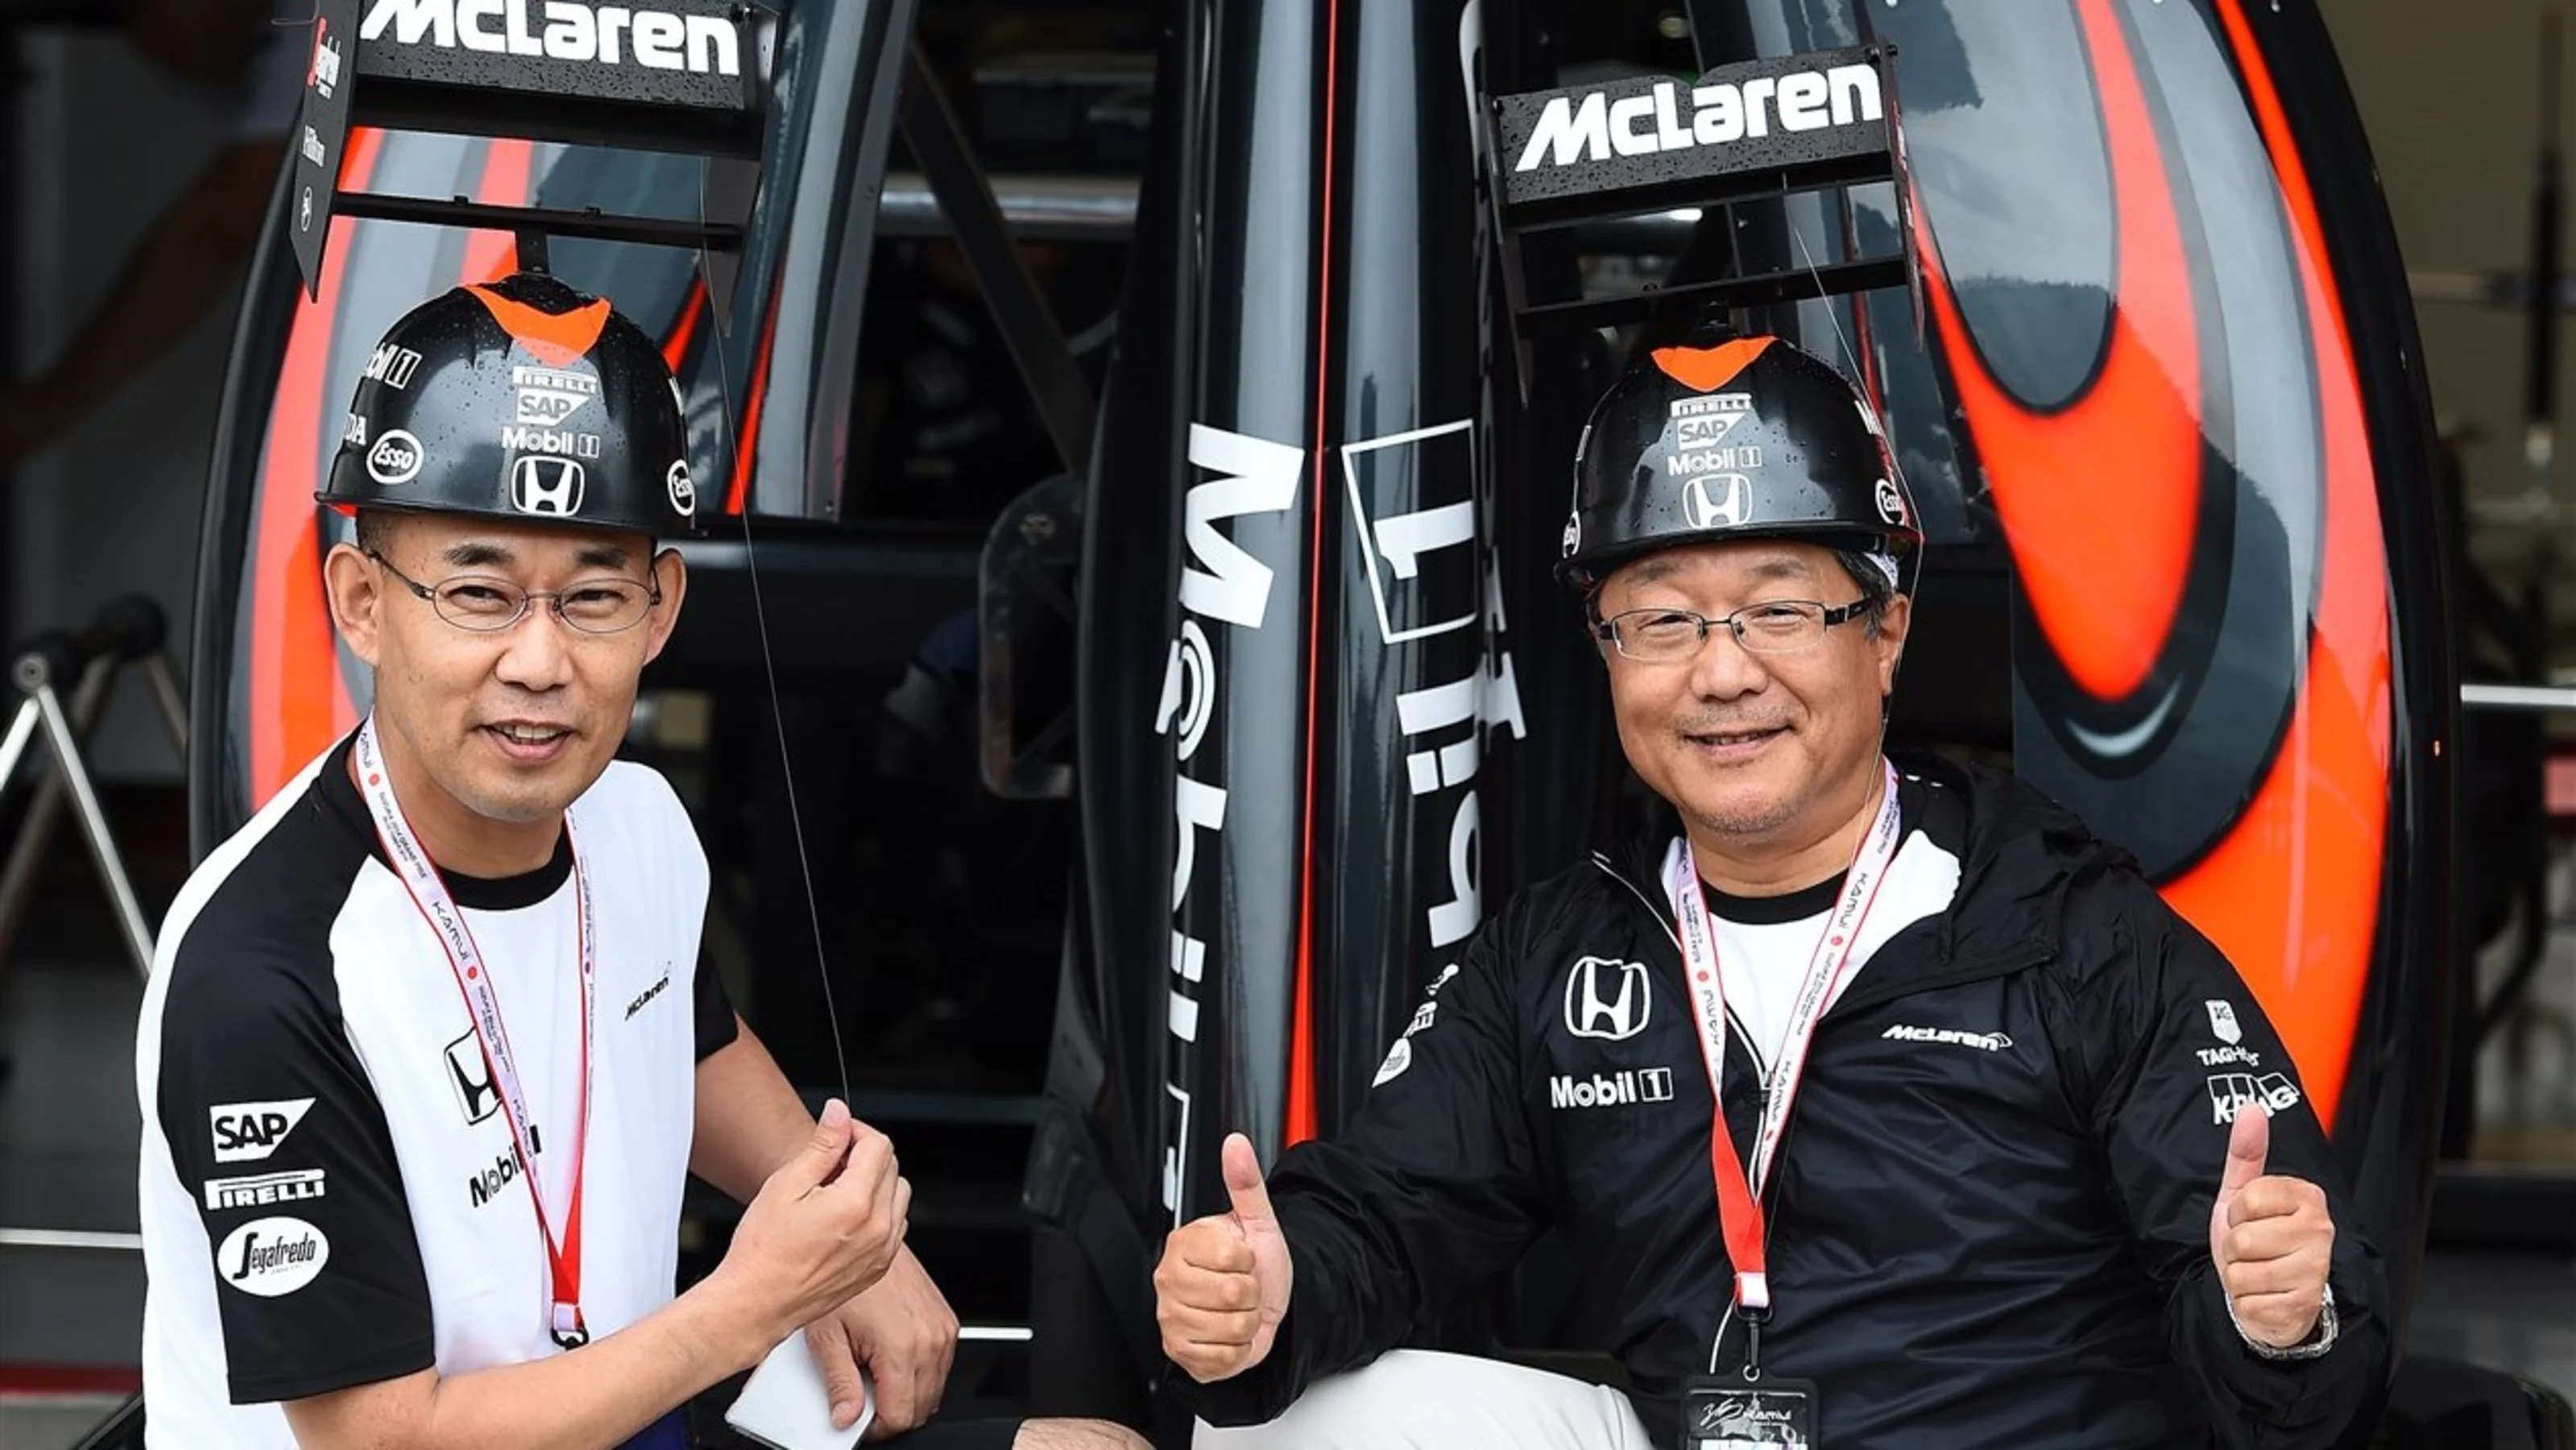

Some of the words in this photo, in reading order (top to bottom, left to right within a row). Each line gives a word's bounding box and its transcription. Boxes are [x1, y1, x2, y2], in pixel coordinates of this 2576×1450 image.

[359, 0, 740, 76] McLaren
[1515, 64, 1882, 172] McLaren
[512, 366, 598, 393] PIRELLI
[520, 394, 571, 420] SAP
[1671, 393, 1751, 417] PIRELLI
[502, 425, 574, 454] Mobil
[1679, 419, 1728, 442] SAP
[1667, 448, 1736, 476] Mobil
[624, 976, 669, 1021] McLaren
[1882, 1024, 1999, 1052] McLaren
[1550, 1071, 1638, 1109] Mobil
[214, 1112, 288, 1150] SAP
[204, 1168, 325, 1211] PIRELLI
[232, 1232, 317, 1281] Segafredo
